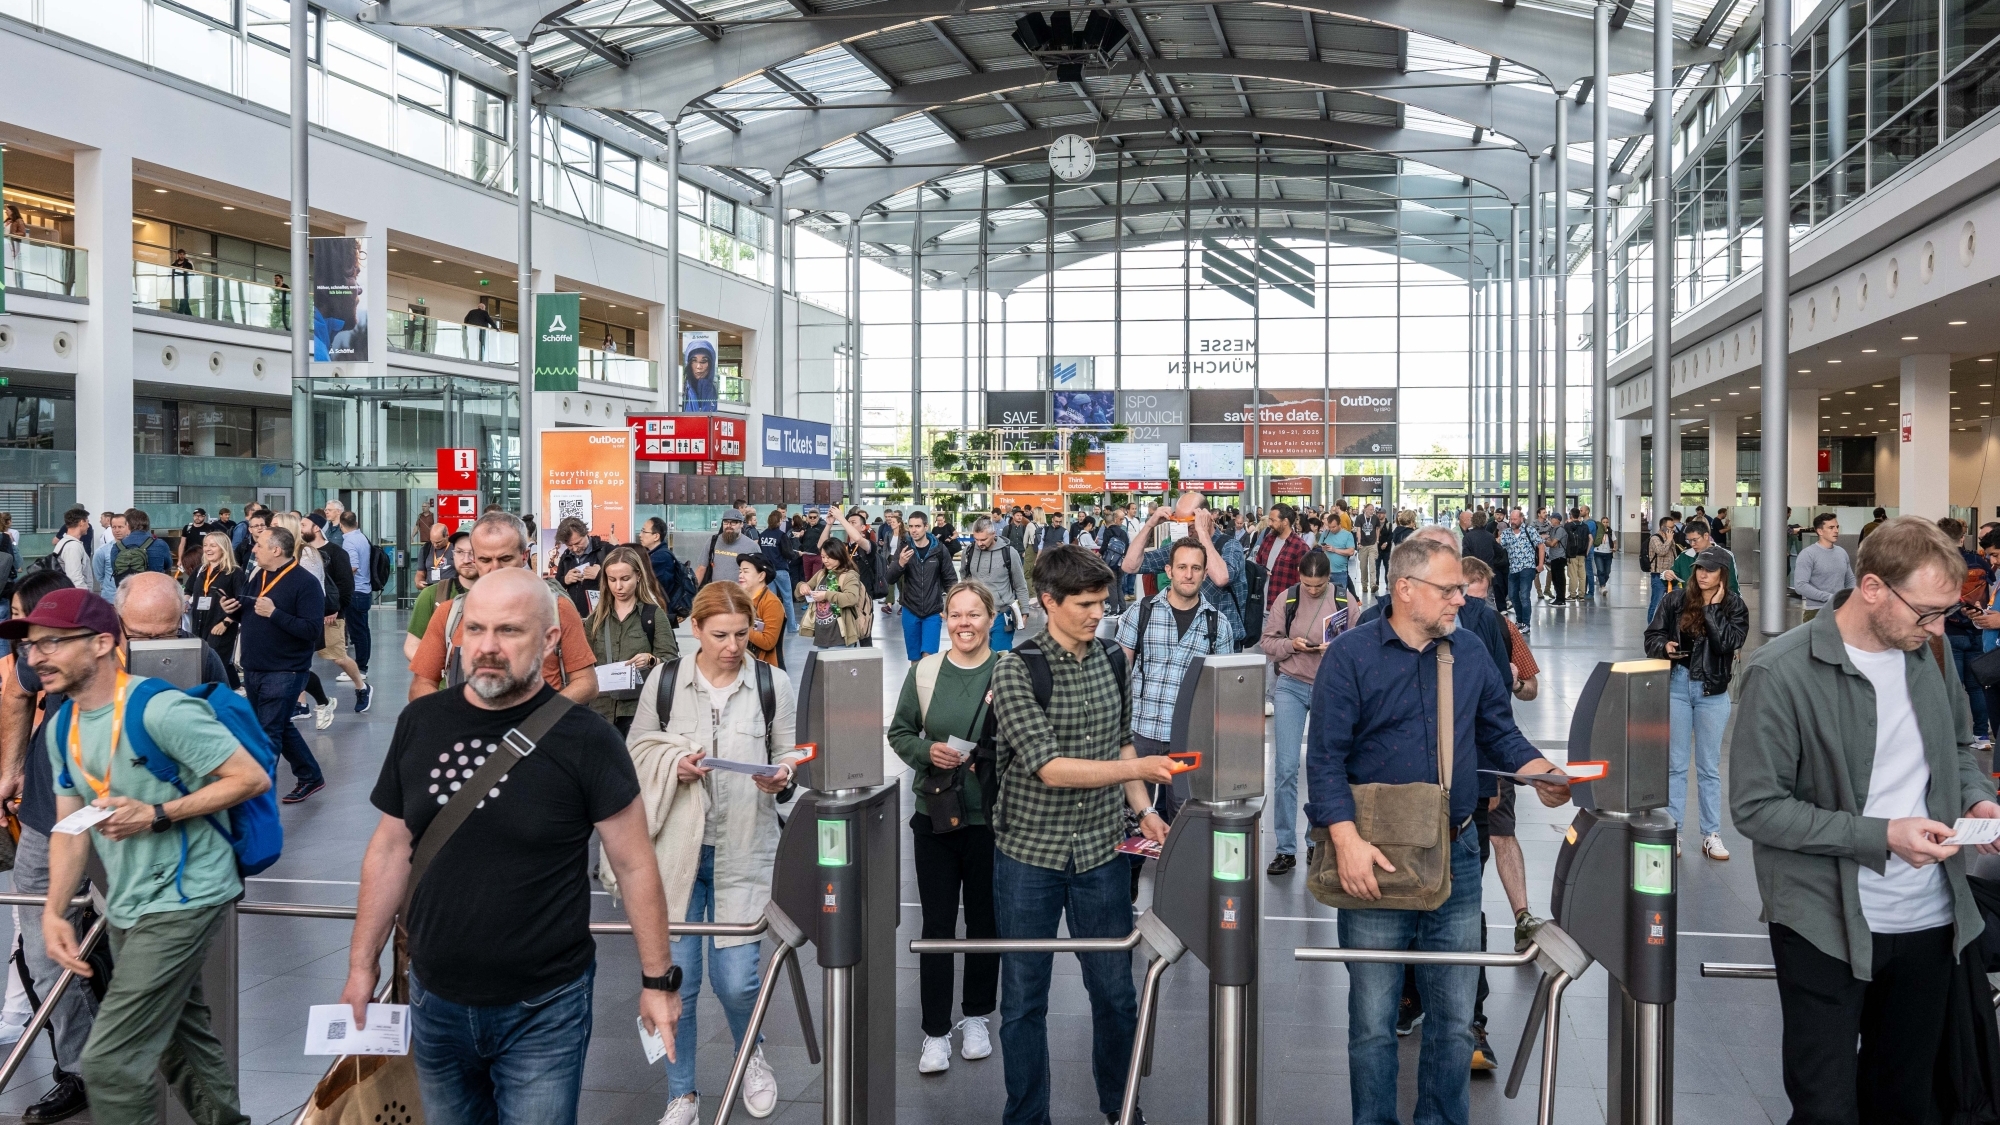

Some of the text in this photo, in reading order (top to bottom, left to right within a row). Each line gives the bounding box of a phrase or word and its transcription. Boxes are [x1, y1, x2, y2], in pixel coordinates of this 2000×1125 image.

[542, 334, 573, 342] Schöffel
[1125, 395, 1157, 409] ISPO
[1340, 395, 1393, 407] OutDoor
[1002, 411, 1038, 424] SAVE
[1125, 411, 1183, 424] MUNICH
[1223, 409, 1323, 422] save the date.
[1002, 426, 1030, 439] THE
[1133, 426, 1161, 440] 024
[588, 435, 626, 444] OutDoor
[783, 429, 813, 455] Tickets
[549, 470, 600, 479] Everything
[822, 905, 837, 913] EXIT
[1220, 921, 1237, 929] EXIT
[1647, 937, 1666, 945] EXIT
